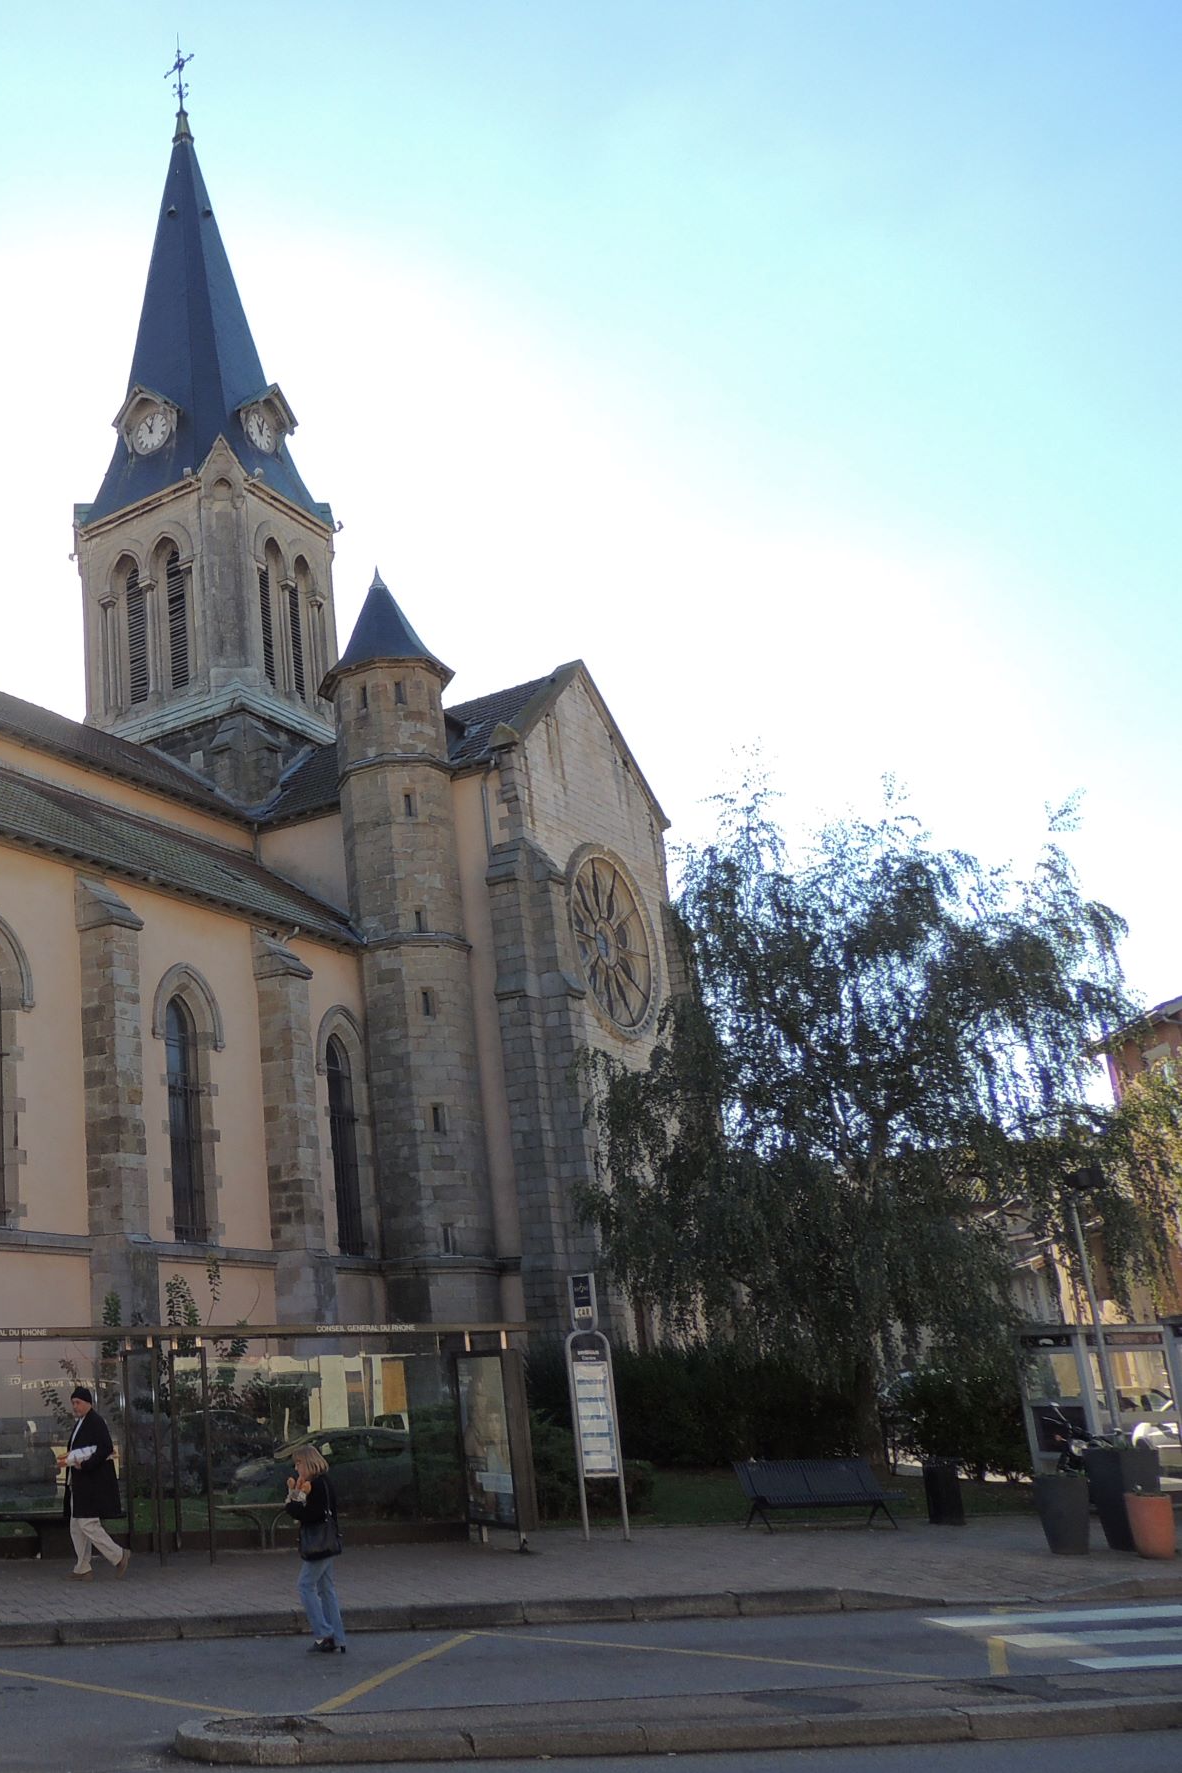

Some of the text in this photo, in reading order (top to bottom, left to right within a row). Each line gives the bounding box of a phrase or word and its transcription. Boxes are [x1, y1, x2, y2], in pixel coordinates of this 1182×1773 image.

[577, 1307, 590, 1317] CAR
[347, 1324, 378, 1332] GENERAL
[379, 1324, 390, 1332] DU
[8, 1329, 19, 1337] DU
